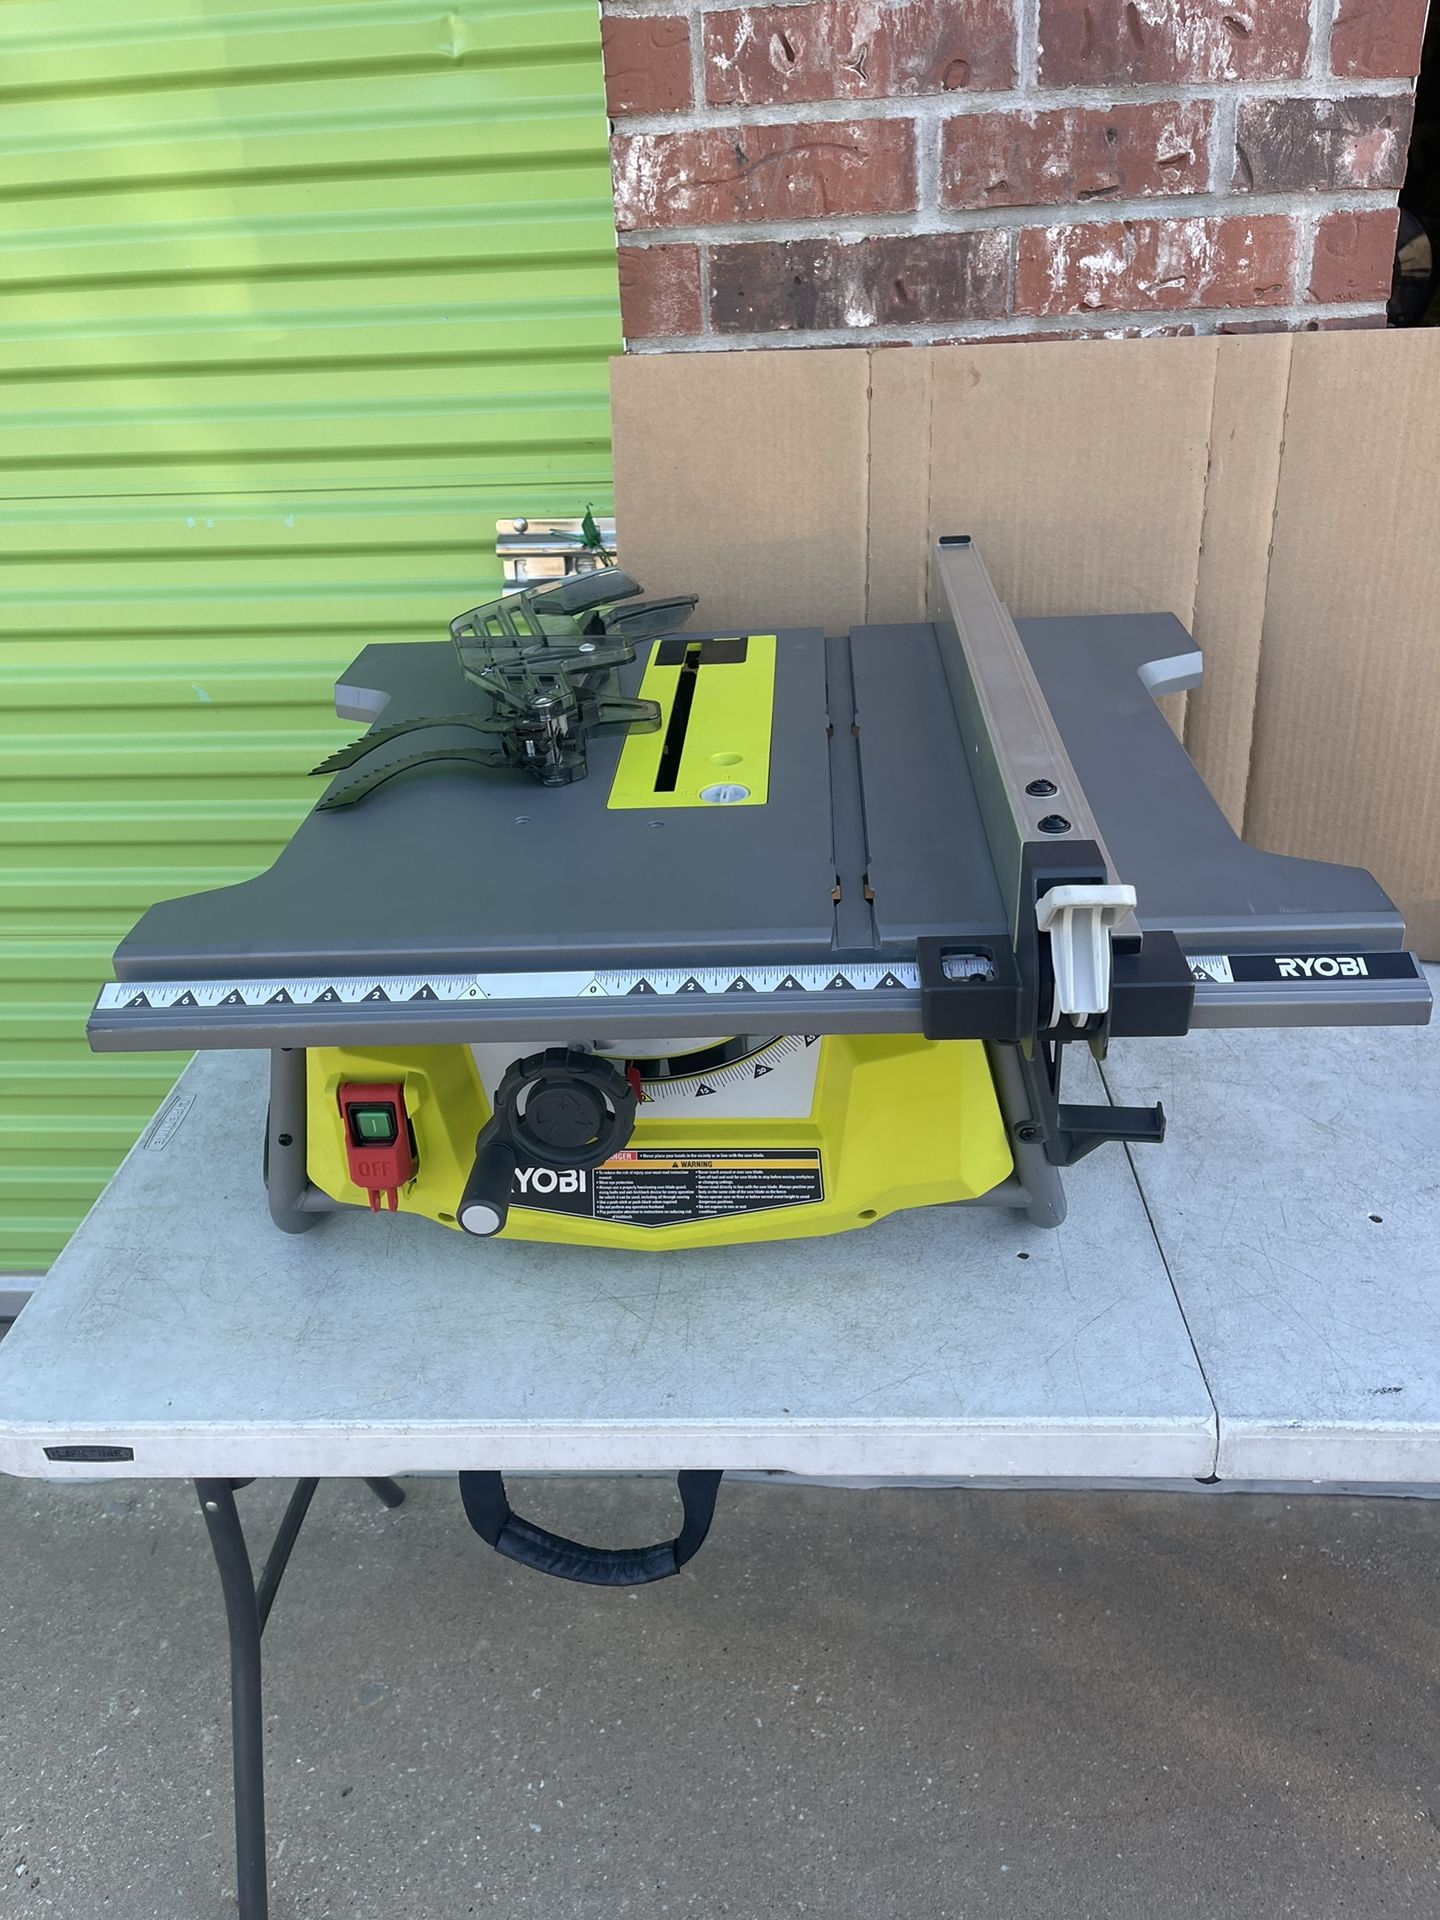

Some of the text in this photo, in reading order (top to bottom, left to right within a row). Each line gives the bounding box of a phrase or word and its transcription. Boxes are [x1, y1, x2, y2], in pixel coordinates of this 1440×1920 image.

[1194, 971, 1207, 980] 12
[1274, 957, 1369, 978] RYOBI
[784, 980, 793, 988] 4
[835, 979, 843, 987] 5
[886, 978, 894, 986] 6
[134, 989, 476, 1006] 7 6 5 4 3 2 1 0
[358, 1161, 391, 1177] OFF
[511, 1168, 586, 1193] YOBI
